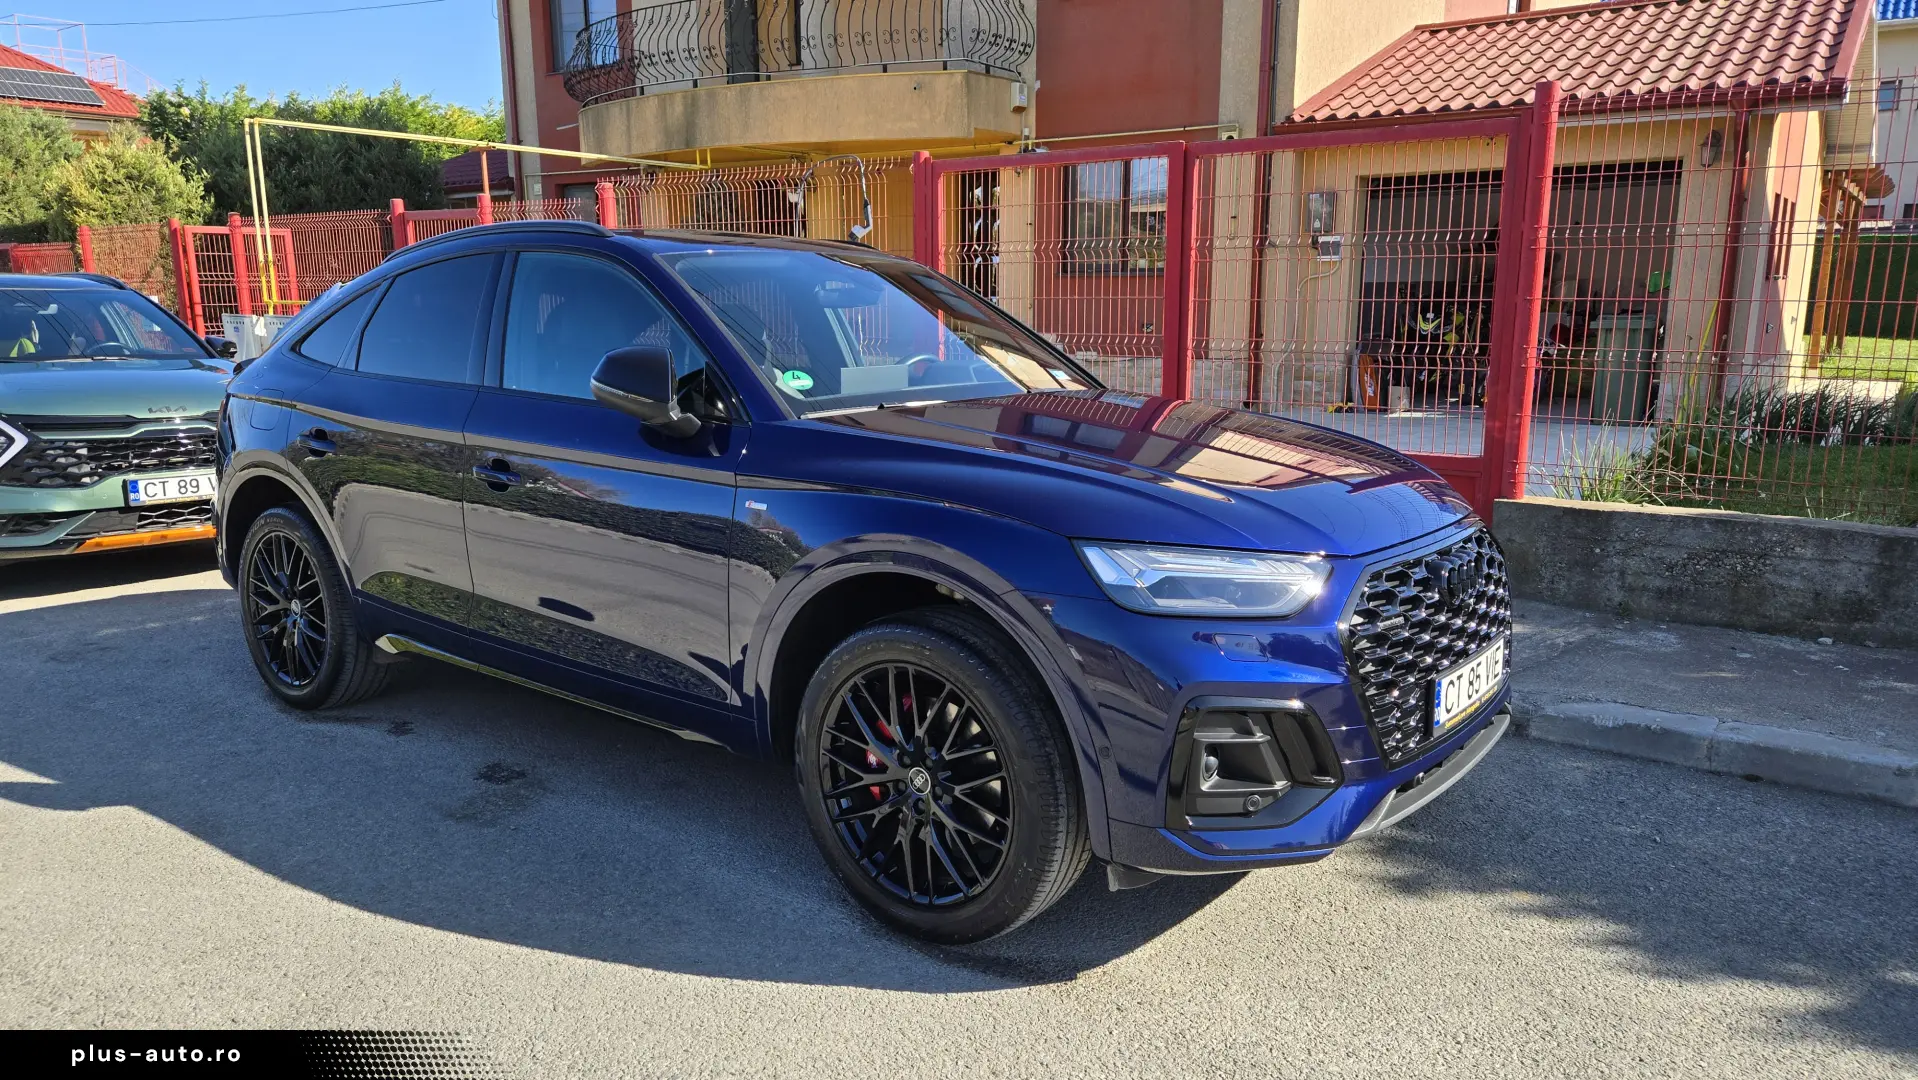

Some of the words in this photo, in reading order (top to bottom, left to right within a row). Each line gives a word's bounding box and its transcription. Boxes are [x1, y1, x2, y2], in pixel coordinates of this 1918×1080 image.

[130, 492, 140, 500] RO
[144, 480, 169, 498] CT
[177, 478, 200, 495] 89
[1444, 672, 1464, 714] CT
[1467, 662, 1482, 701] 85
[1486, 645, 1501, 686] VIE
